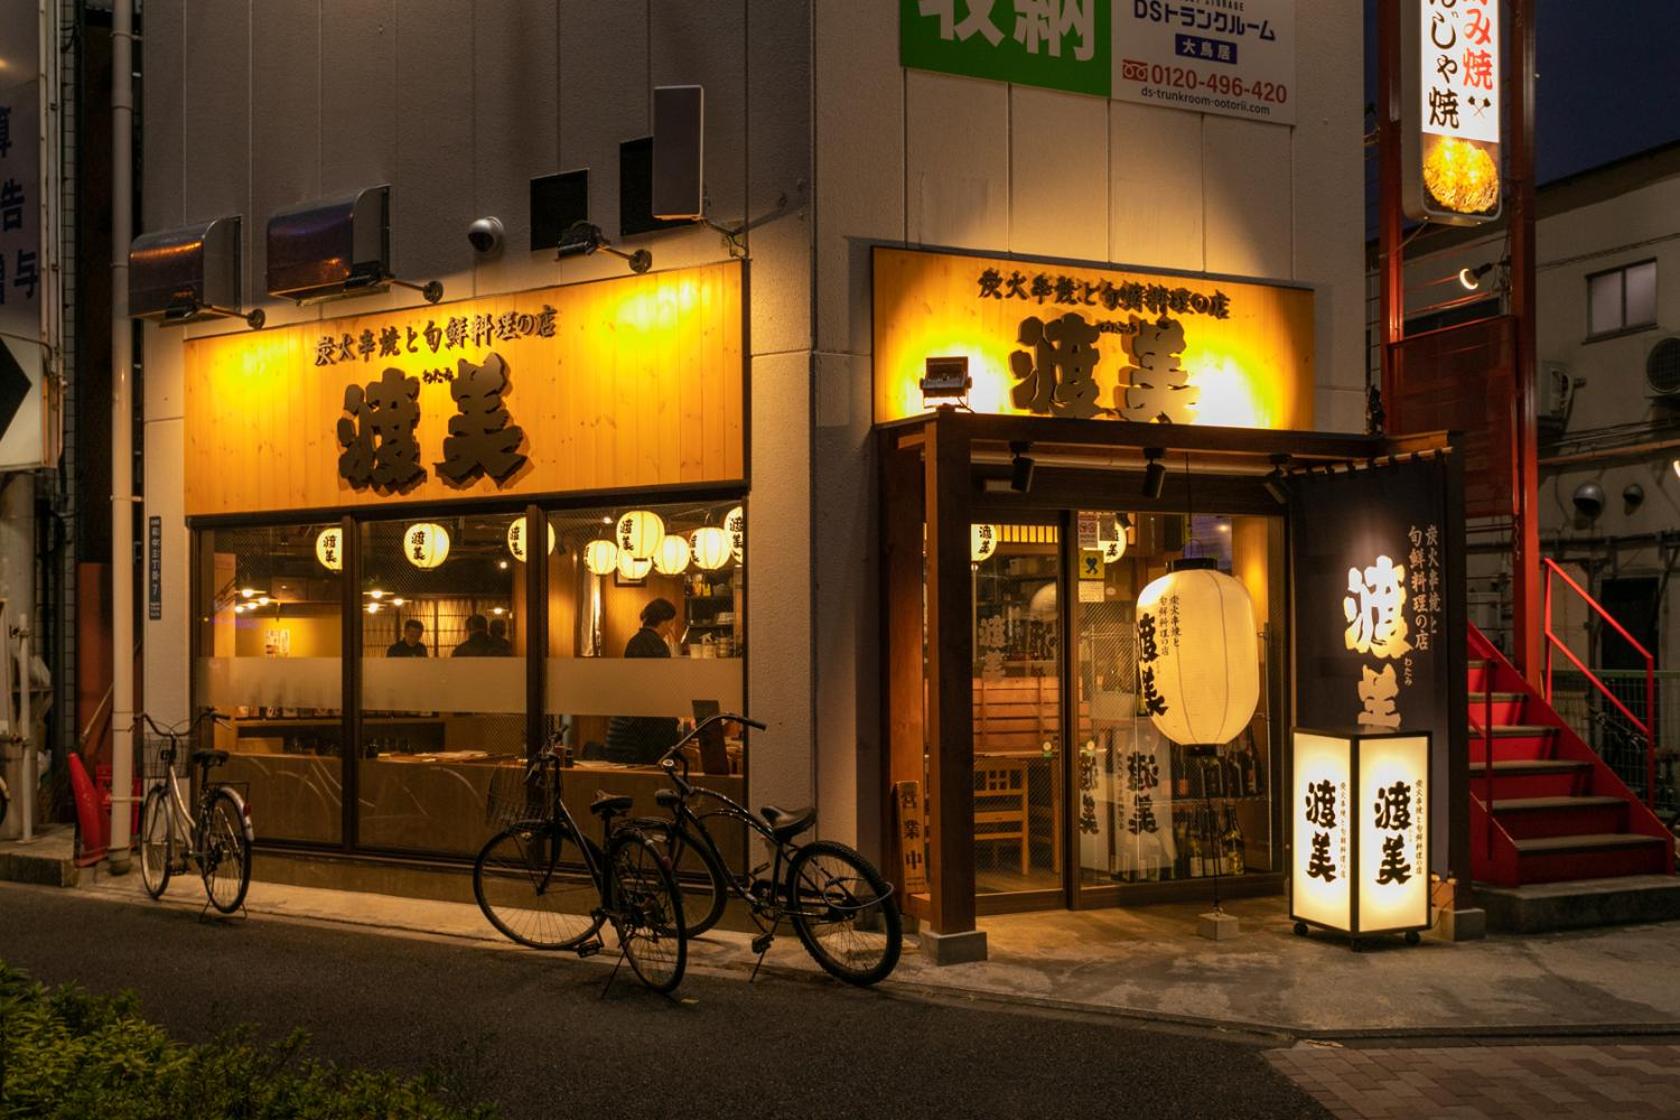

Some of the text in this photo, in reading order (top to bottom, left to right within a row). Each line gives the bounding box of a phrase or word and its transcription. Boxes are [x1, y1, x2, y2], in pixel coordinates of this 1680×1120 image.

[1134, 0, 1276, 41] DSトランクルーム
[1183, 38, 1233, 61] 大鳥居
[1428, 0, 1459, 129] じゃ焼
[1462, 0, 1493, 91] み焼
[1151, 64, 1288, 104] 0120-496-420
[315, 304, 558, 367] 炭火串焼と旬鮮料理の店
[336, 351, 532, 493] 渡美
[1408, 525, 1429, 651] 旬鮮料理の店
[1425, 524, 1441, 635] 炭火串焼と
[1343, 554, 1413, 729] 渡美
[1305, 779, 1337, 883] 渡美
[1374, 780, 1412, 886] 渡美
